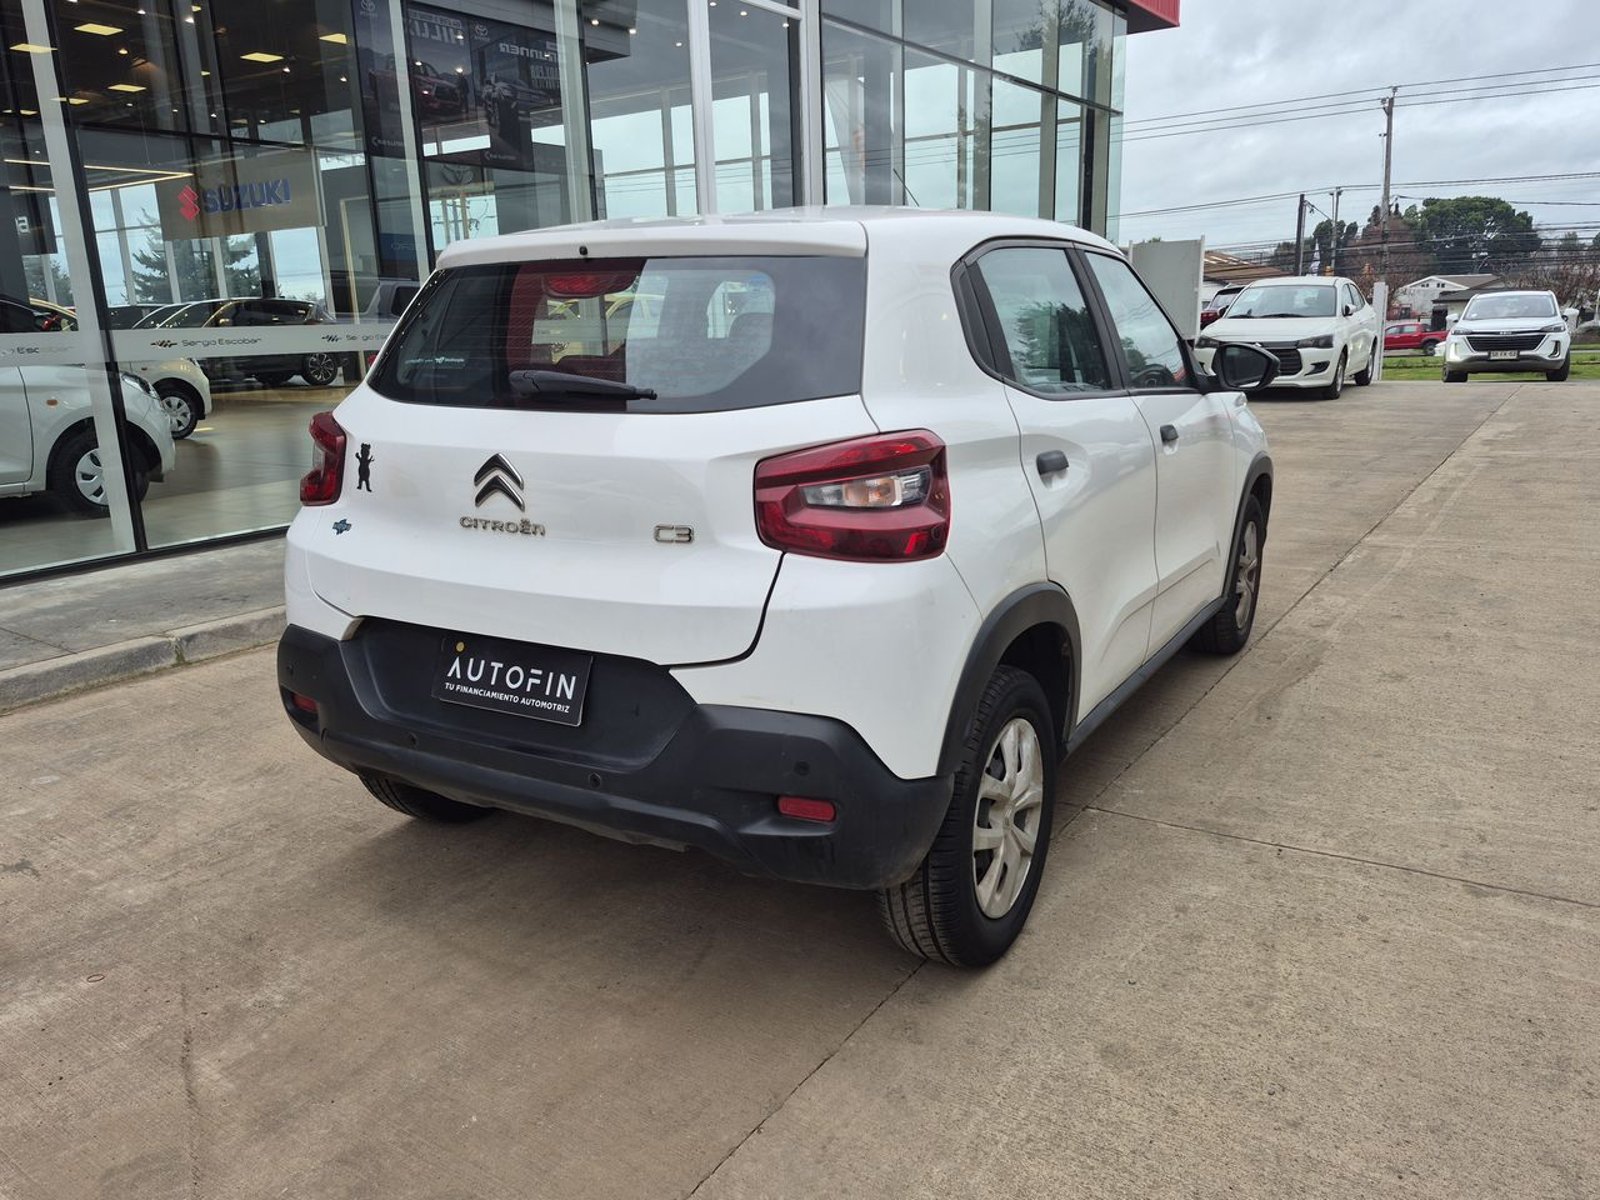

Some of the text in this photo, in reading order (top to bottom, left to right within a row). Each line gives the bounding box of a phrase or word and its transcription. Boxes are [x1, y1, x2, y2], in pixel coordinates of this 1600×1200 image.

[203, 178, 292, 213] SUZUKI
[218, 338, 262, 346] Escobar
[654, 524, 694, 543] C3
[447, 655, 577, 700] AUTOFIN
[444, 682, 570, 713] TU FINANCIAMIENTO AUTOMOTRIZ
